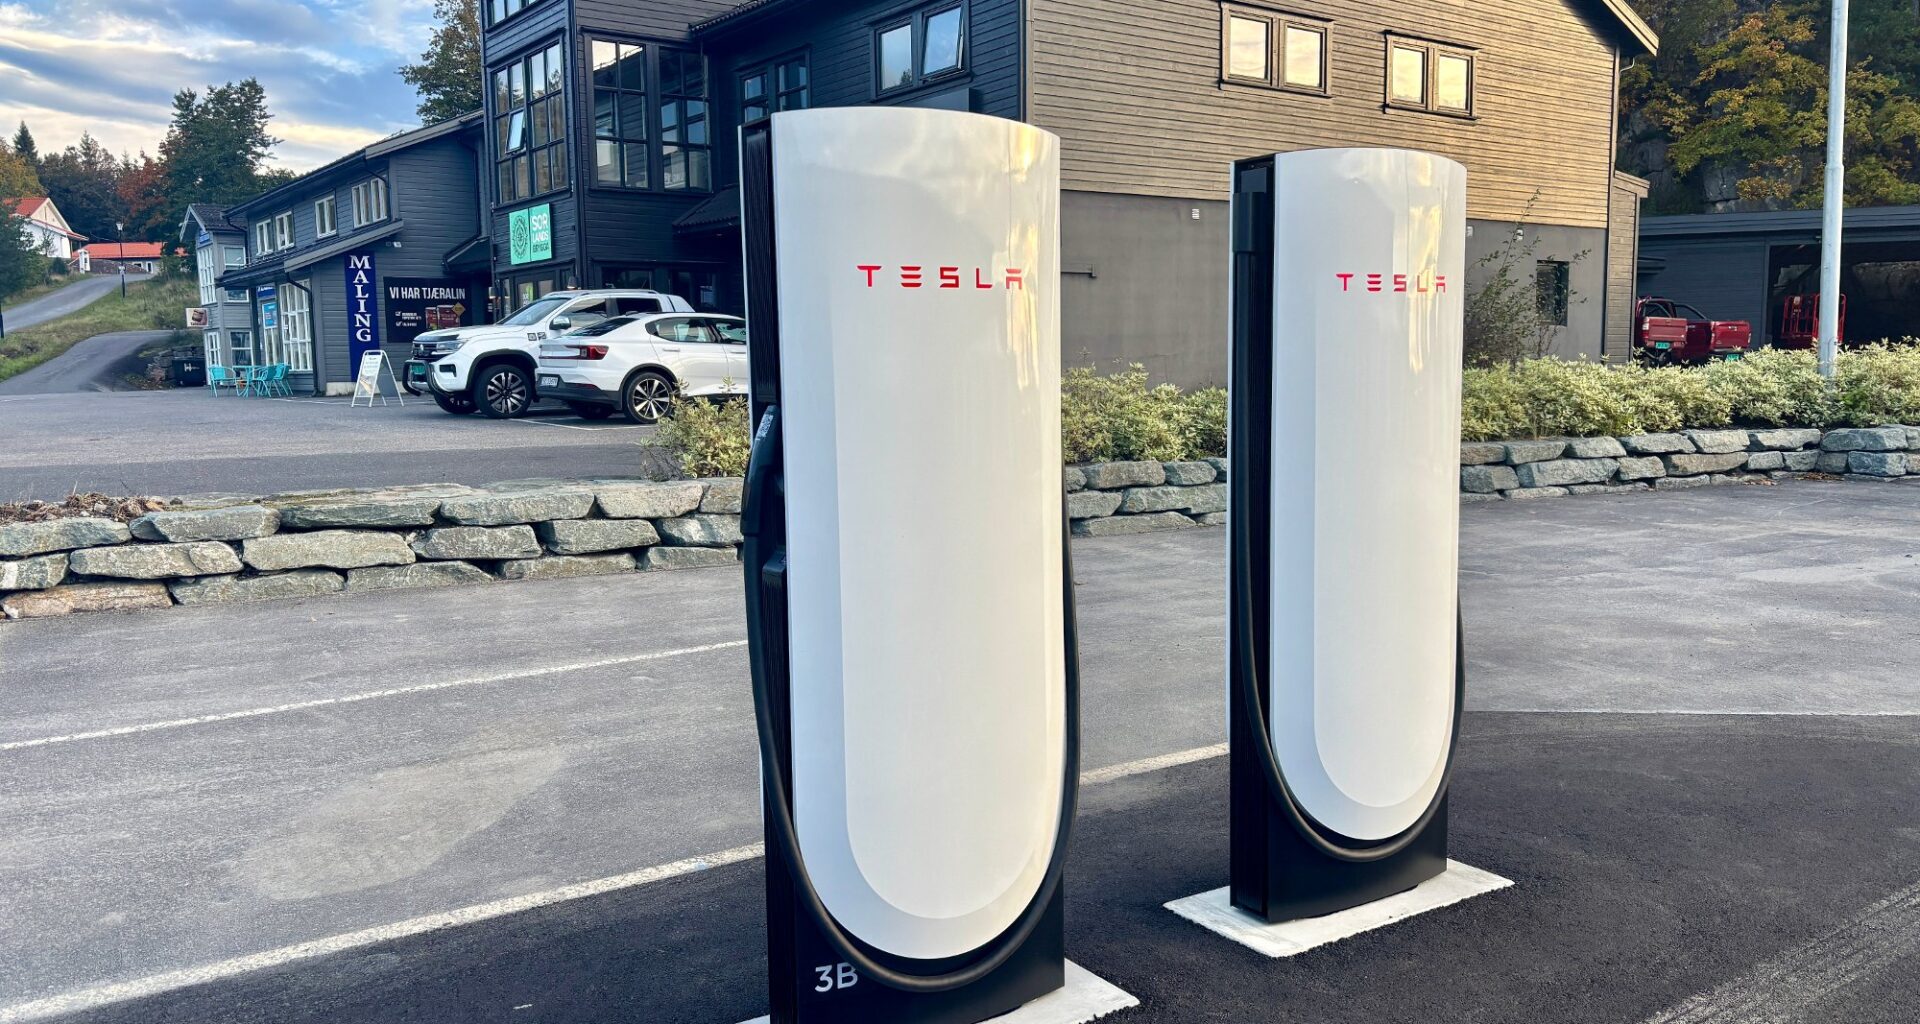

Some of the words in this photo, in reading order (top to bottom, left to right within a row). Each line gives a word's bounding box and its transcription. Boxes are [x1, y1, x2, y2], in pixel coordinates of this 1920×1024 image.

[856, 265, 1022, 290] TESLA
[1336, 273, 1446, 293] TESLA
[349, 255, 372, 342] MALING
[389, 286, 399, 299] VI
[401, 286, 420, 299] HAR
[422, 287, 466, 299] TJÆRALIN
[814, 962, 858, 992] 3B
